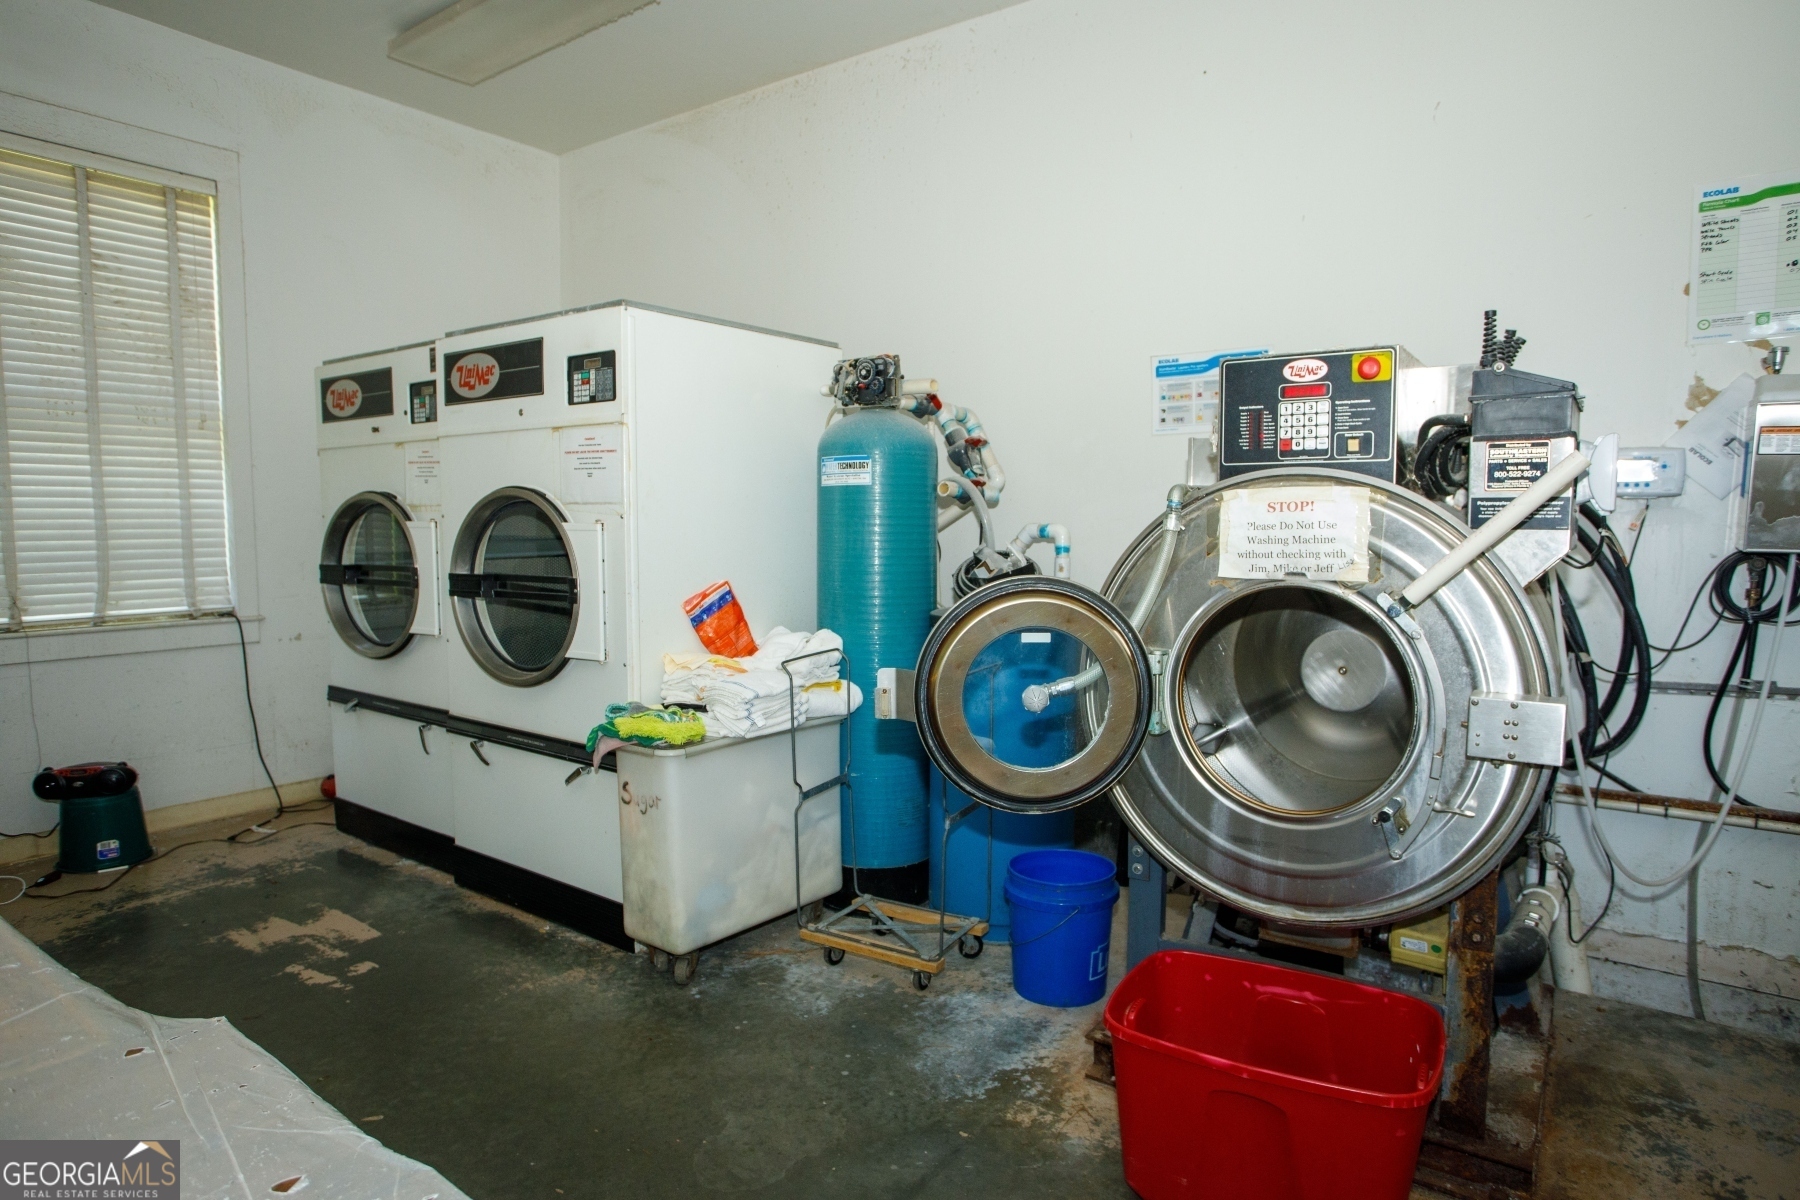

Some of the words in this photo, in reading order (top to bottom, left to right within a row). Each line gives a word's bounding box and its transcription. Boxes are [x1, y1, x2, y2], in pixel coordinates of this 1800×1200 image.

[1703, 187, 1740, 198] ECOLAB
[1288, 363, 1324, 378] UniMac
[456, 364, 495, 391] UniMac
[329, 388, 359, 411] UniMac
[837, 461, 870, 470] TECHNOLOGY
[1267, 500, 1315, 513] STOP!
[1279, 521, 1293, 530] Do
[1296, 520, 1315, 530] Not
[1318, 520, 1338, 530] Use
[1247, 535, 1289, 546] Washing
[1292, 534, 1336, 544] Machine
[1237, 549, 1274, 559] without
[1276, 549, 1321, 561] checking
[1323, 548, 1347, 558] with
[1248, 564, 1270, 574] Jim,
[1300, 565, 1312, 573] or
[1314, 563, 1335, 573] Jeff
